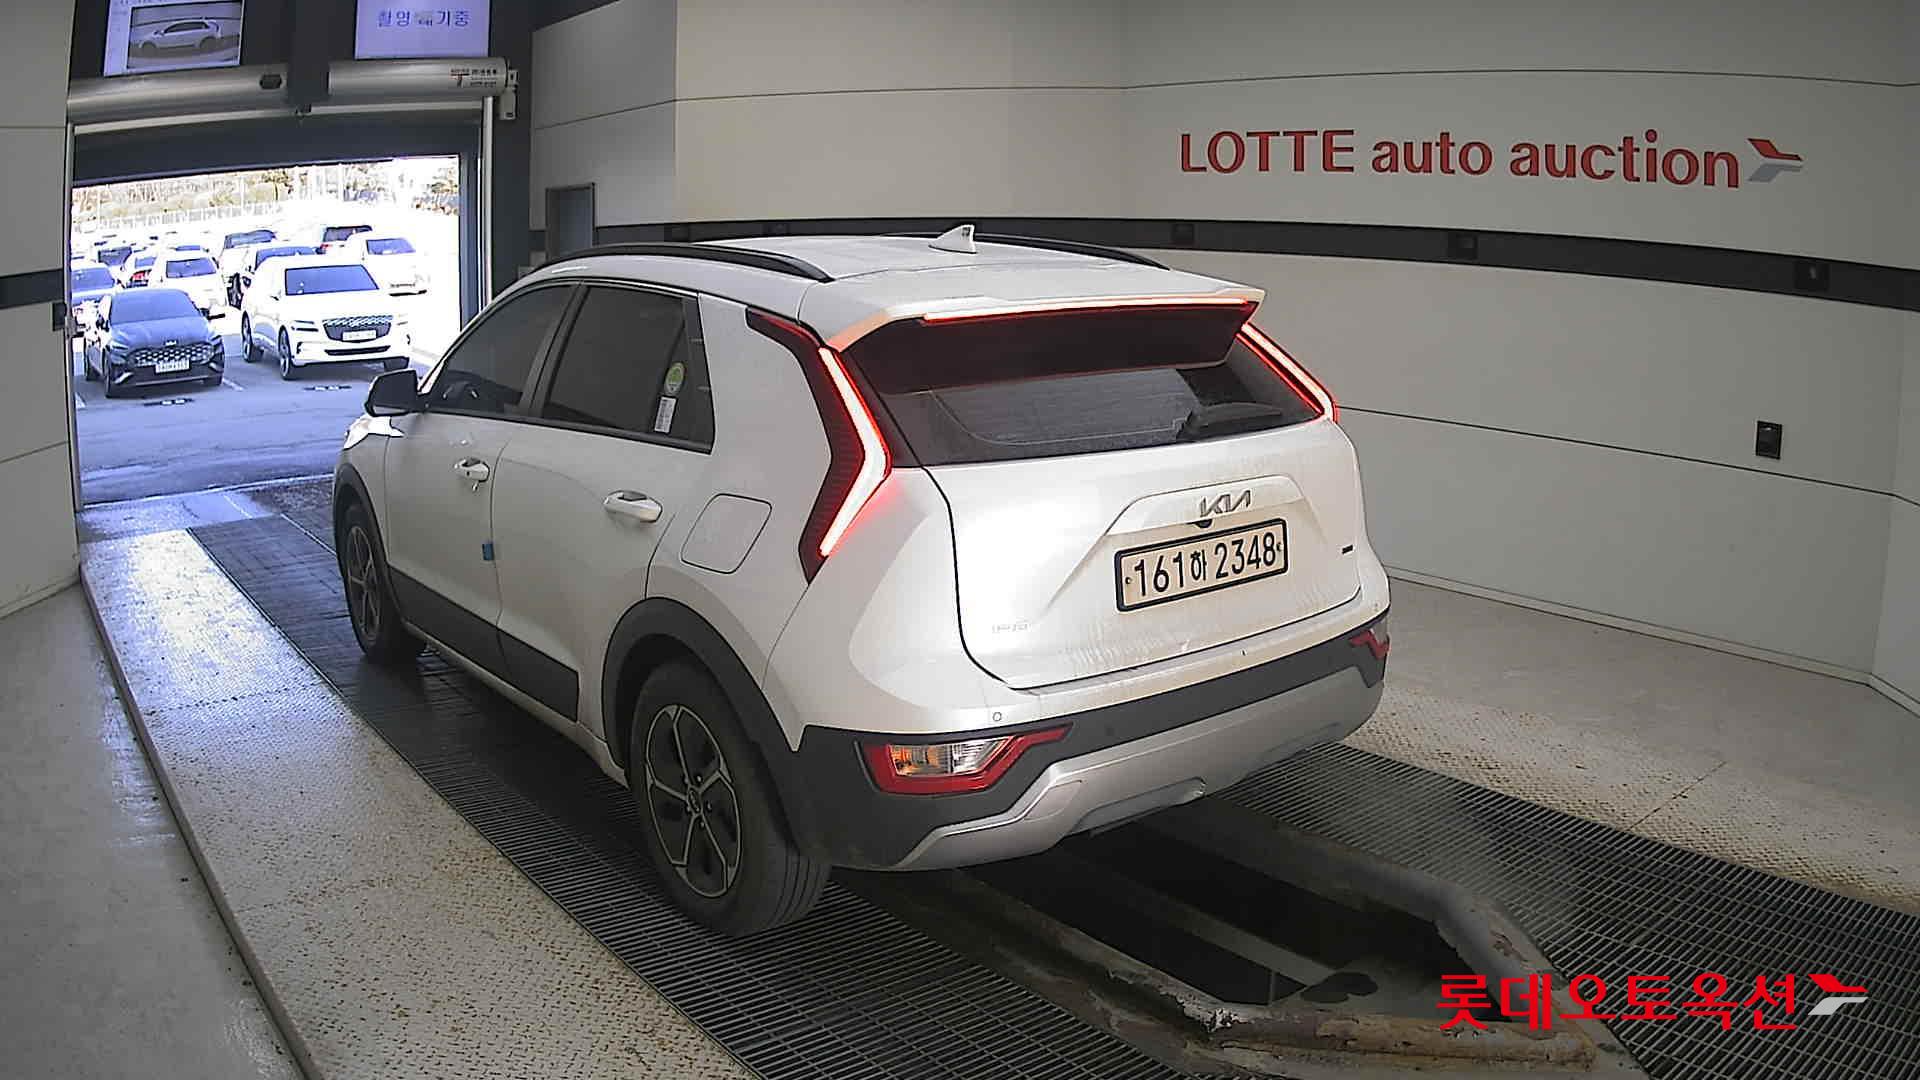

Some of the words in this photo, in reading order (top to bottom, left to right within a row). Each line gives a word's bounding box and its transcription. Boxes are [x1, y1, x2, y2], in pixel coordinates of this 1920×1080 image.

[1180, 129, 1355, 173] LOTTE
[1371, 131, 1493, 176] auto
[1509, 129, 1740, 189] auction
[1134, 549, 1207, 597] 161하
[1214, 531, 1276, 580] 2348
